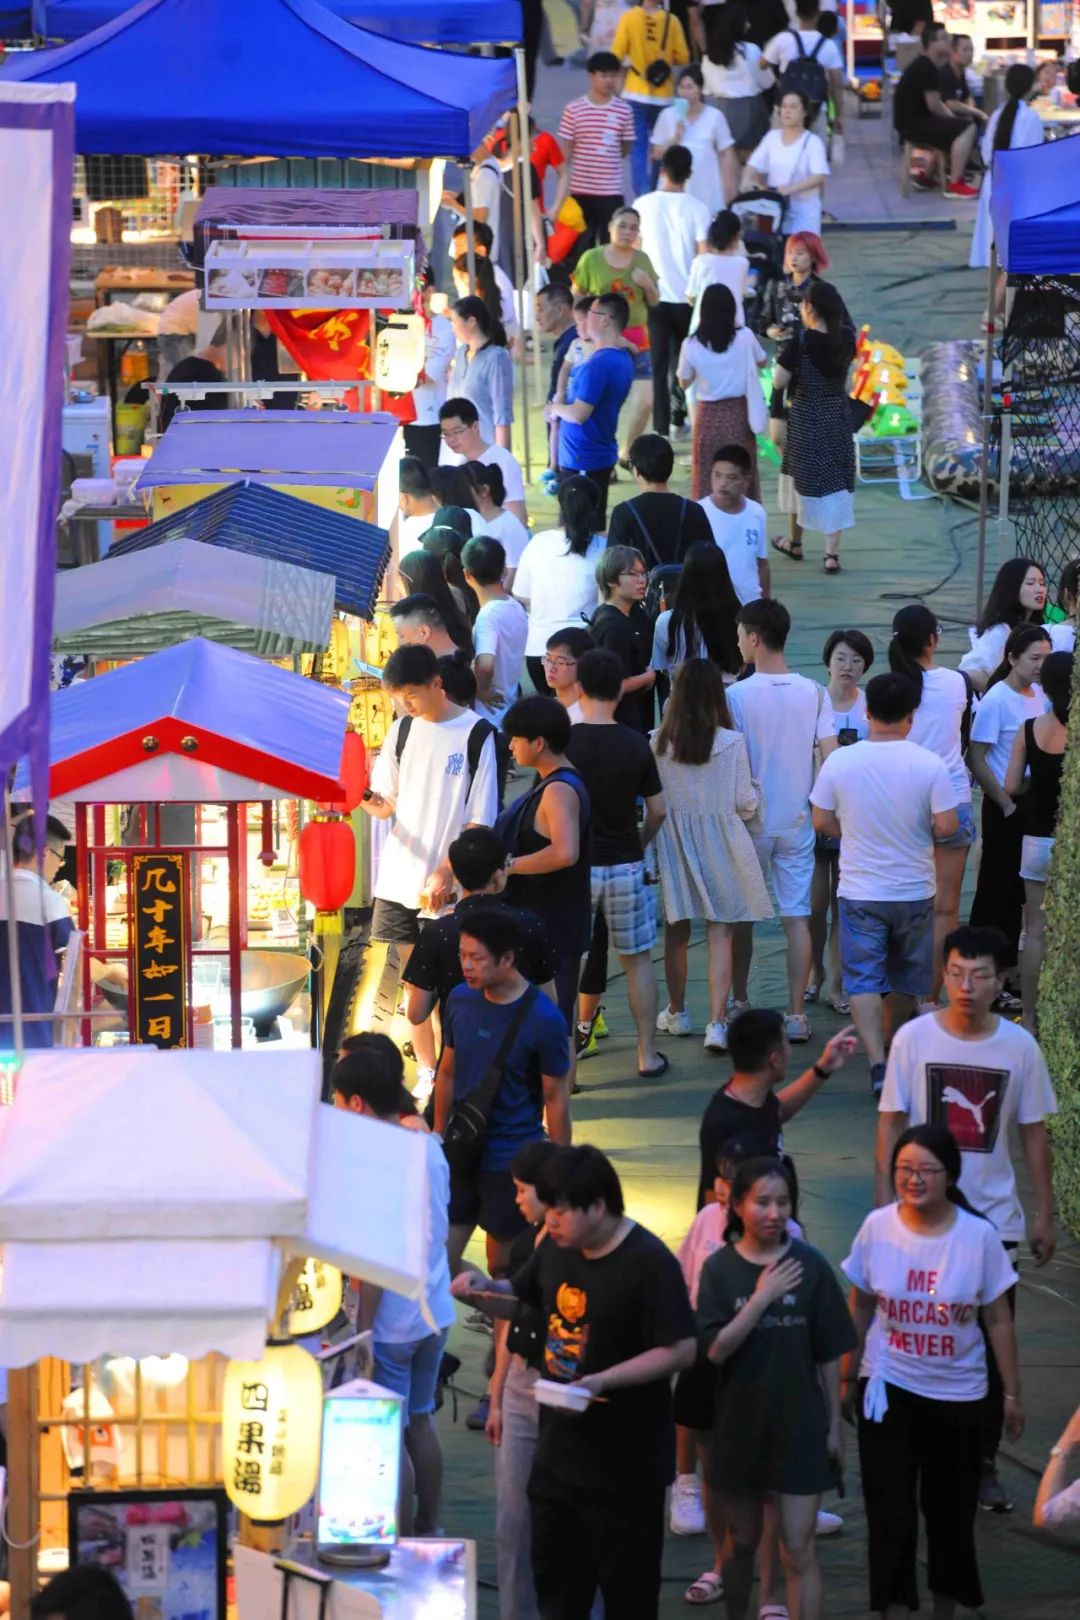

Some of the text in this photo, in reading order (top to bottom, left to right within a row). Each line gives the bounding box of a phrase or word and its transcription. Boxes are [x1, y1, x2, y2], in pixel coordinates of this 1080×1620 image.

[142, 868, 179, 1040] 几十年如一日
[906, 1269, 938, 1293] ME
[888, 1328, 955, 1358] NEVER
